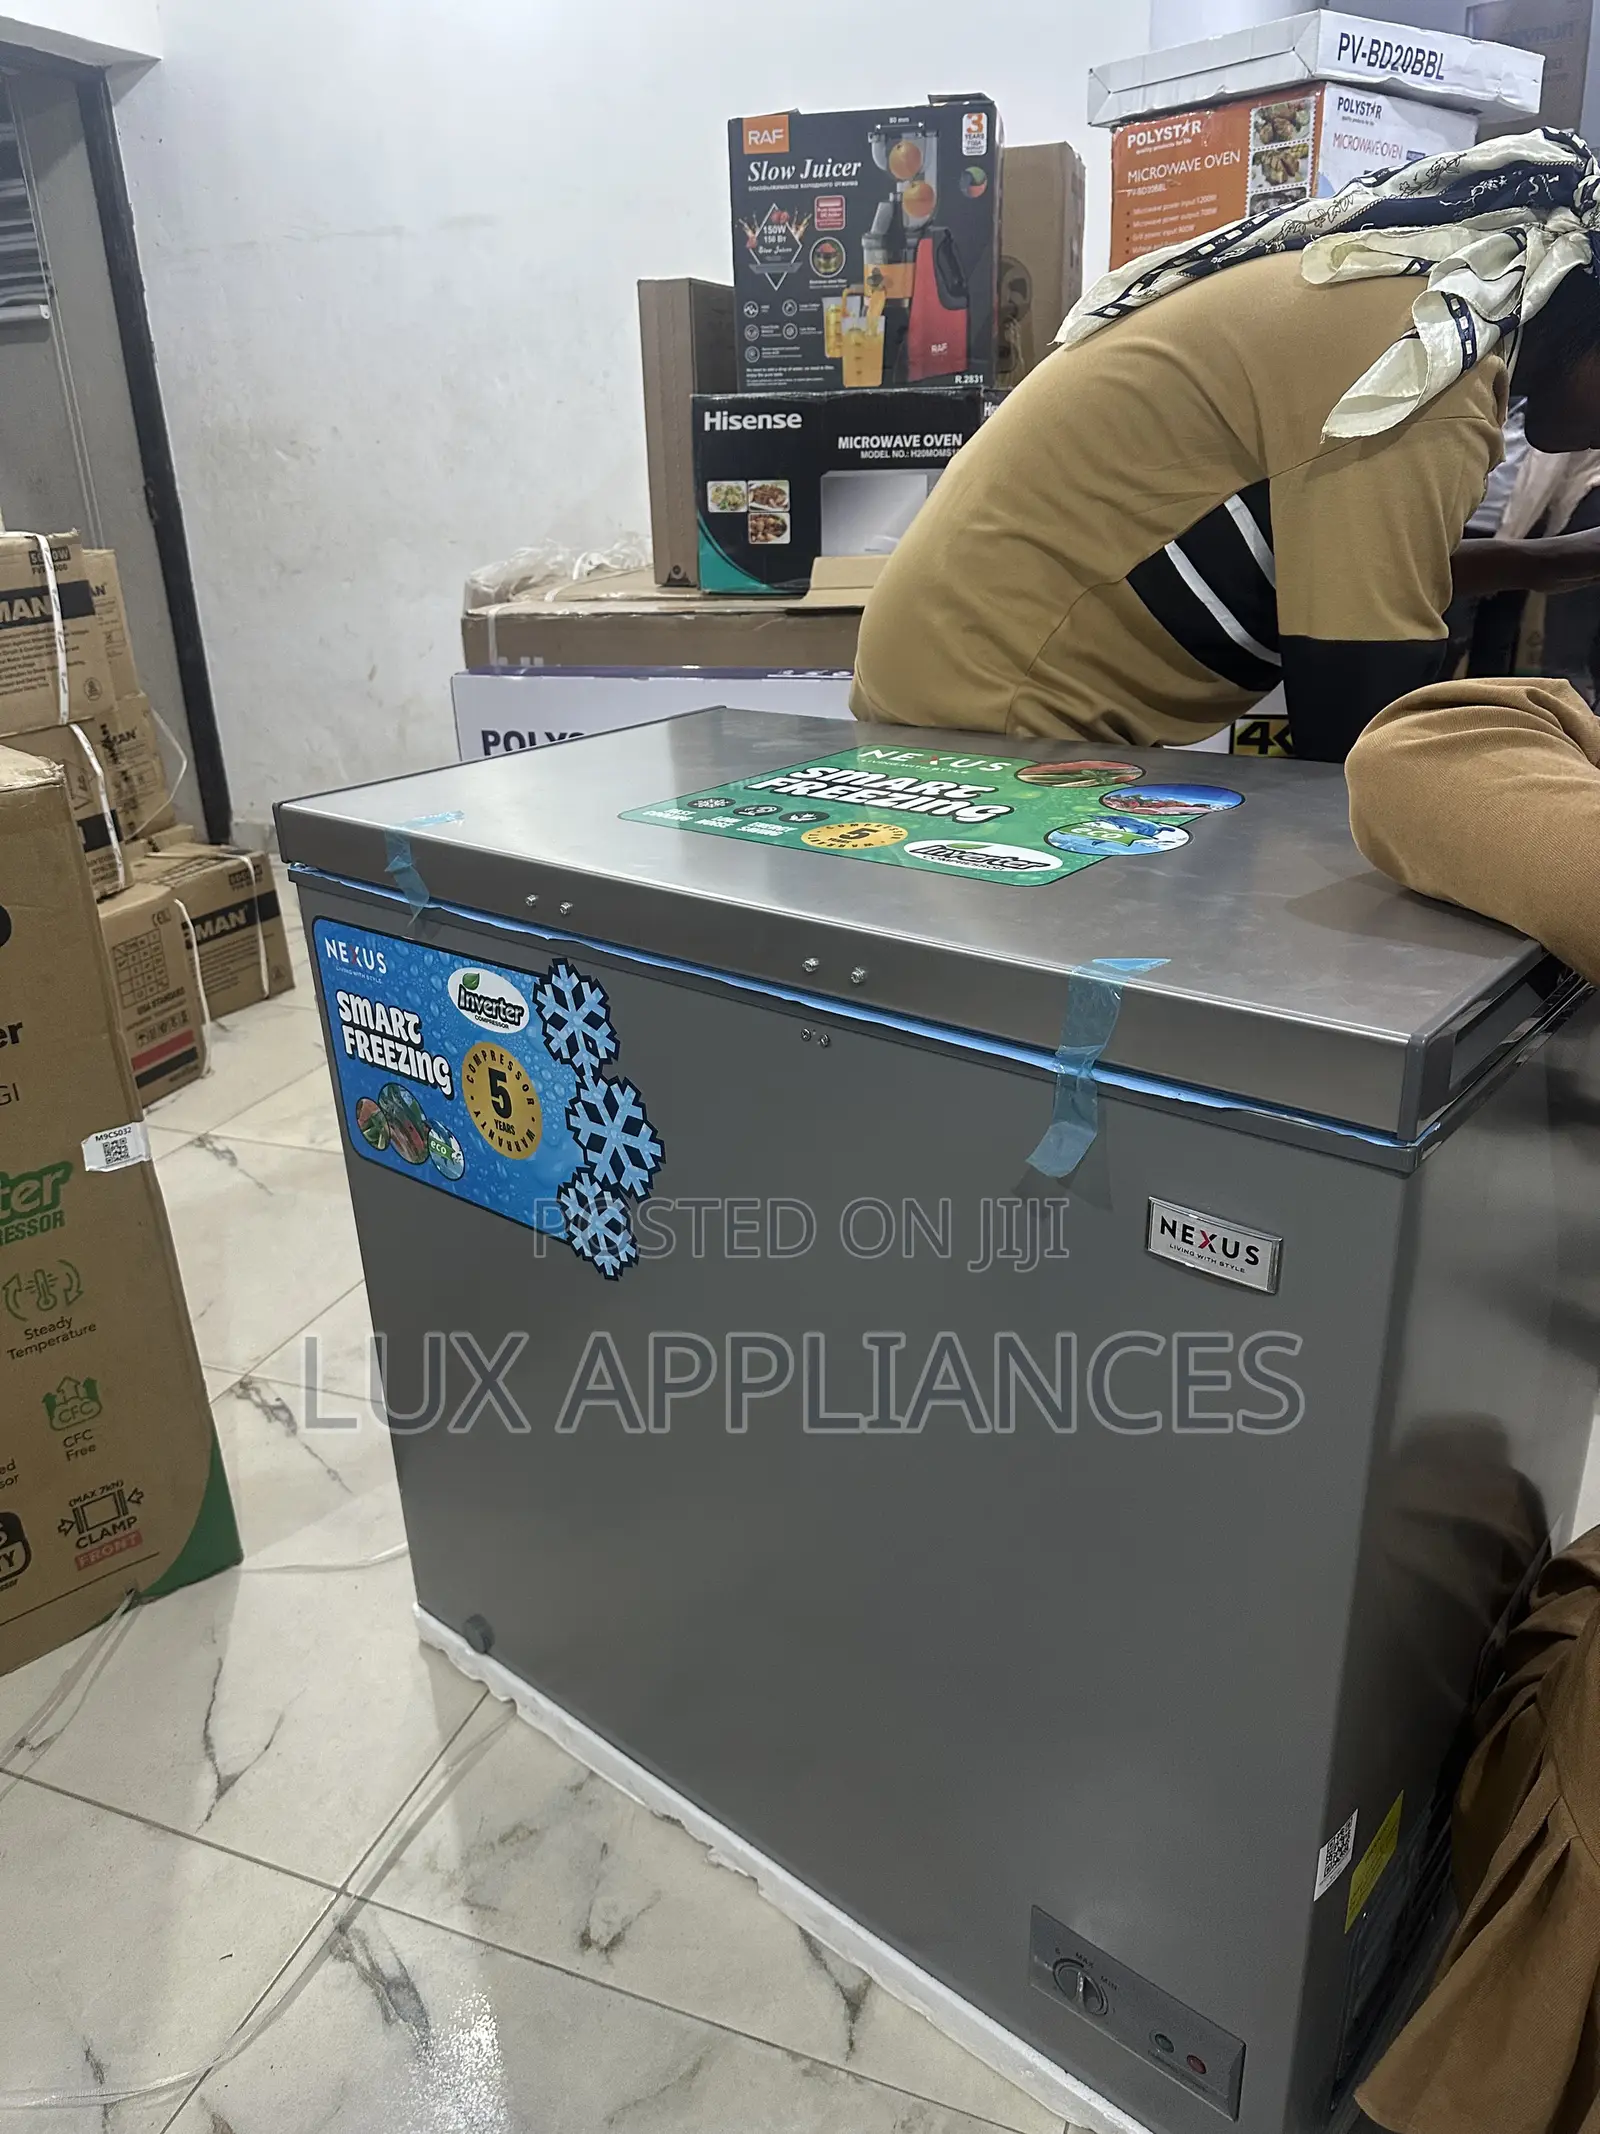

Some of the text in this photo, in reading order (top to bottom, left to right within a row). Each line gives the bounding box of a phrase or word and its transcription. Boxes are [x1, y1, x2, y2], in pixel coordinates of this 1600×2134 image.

[1338, 33, 1445, 80] PV-BD20BBL
[966, 113, 983, 133] 3
[748, 129, 784, 146] RAF
[1333, 133, 1380, 156] MICROWAVE
[1380, 143, 1404, 160] OVEN
[747, 158, 861, 182] Slow Juicer
[1127, 149, 1241, 183] MICROWAVE OVEN
[763, 224, 787, 234] 150W
[954, 374, 984, 384] R.2831
[704, 411, 803, 432] Hisense
[838, 433, 963, 450] MICROWAVE OVEN
[860, 450, 891, 459] MODEL
[858, 749, 1012, 772] NEXUS
[793, 766, 998, 800] SMART
[747, 776, 1013, 823] FREEZING
[838, 828, 879, 840] 5
[1070, 827, 1123, 839] eco
[909, 844, 1051, 870] Inverter
[923, 855, 1005, 872] COMPRESSOR
[324, 936, 387, 974] NEXUS
[458, 984, 525, 1027] Inverter
[336, 990, 424, 1047] SMART
[474, 1014, 510, 1030] COMPRESSOR
[341, 1024, 454, 1098] FREEZING
[466, 1049, 534, 1106] COMPRESSOR
[488, 1067, 512, 1119] 5
[95, 1126, 132, 1142] M9CS032
[474, 1109, 536, 1152] WARRANTY
[494, 1118, 516, 1136] YEARS
[430, 1140, 446, 1154] eco
[1160, 1215, 1260, 1266] NEXUS
[1169, 1242, 1246, 1274] LIVING WITH STYLE
[24, 1316, 74, 1341] Steady
[7, 1322, 97, 1361] Temperature
[58, 1400, 94, 1424] CFC
[63, 1428, 94, 1448] CFC
[65, 1444, 97, 1462] Free
[75, 1516, 138, 1550] CLAMP
[78, 1533, 137, 1568] FRONT
